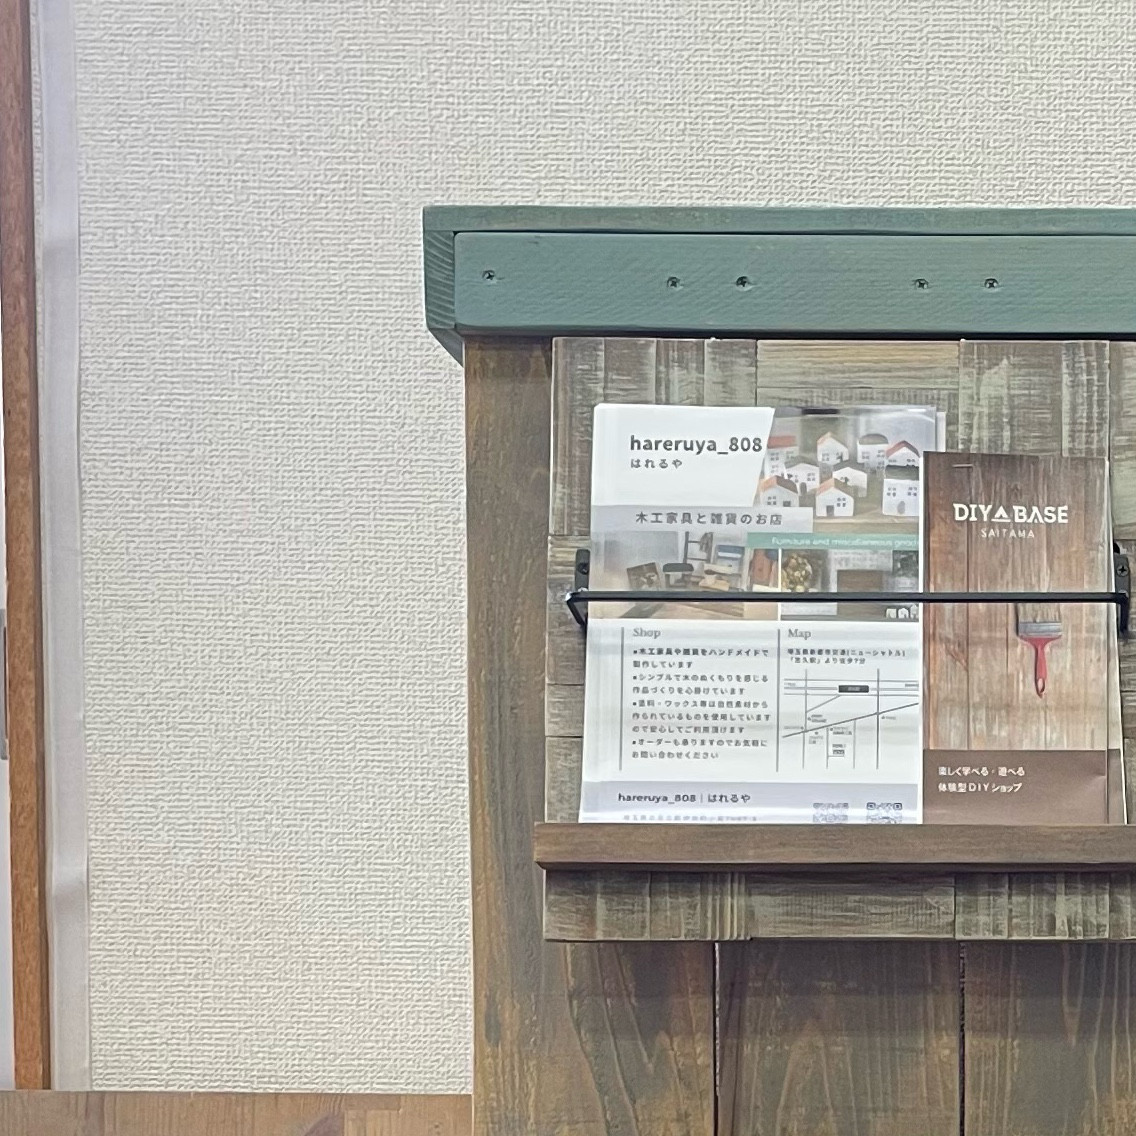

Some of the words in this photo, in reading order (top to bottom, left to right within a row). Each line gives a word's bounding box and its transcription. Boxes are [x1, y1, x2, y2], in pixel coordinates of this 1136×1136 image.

[630, 434, 763, 456] hareruya_808
[630, 458, 683, 469] はれるや
[635, 511, 783, 526] 木工家具と雑貨のお店
[953, 503, 992, 522] DIY
[1012, 504, 1069, 524] BASE
[980, 528, 1035, 539] SAITAMA
[632, 627, 661, 639] Shop
[787, 628, 812, 640] Map
[617, 792, 697, 805] hareruya_808
[707, 793, 751, 803] はれるや
